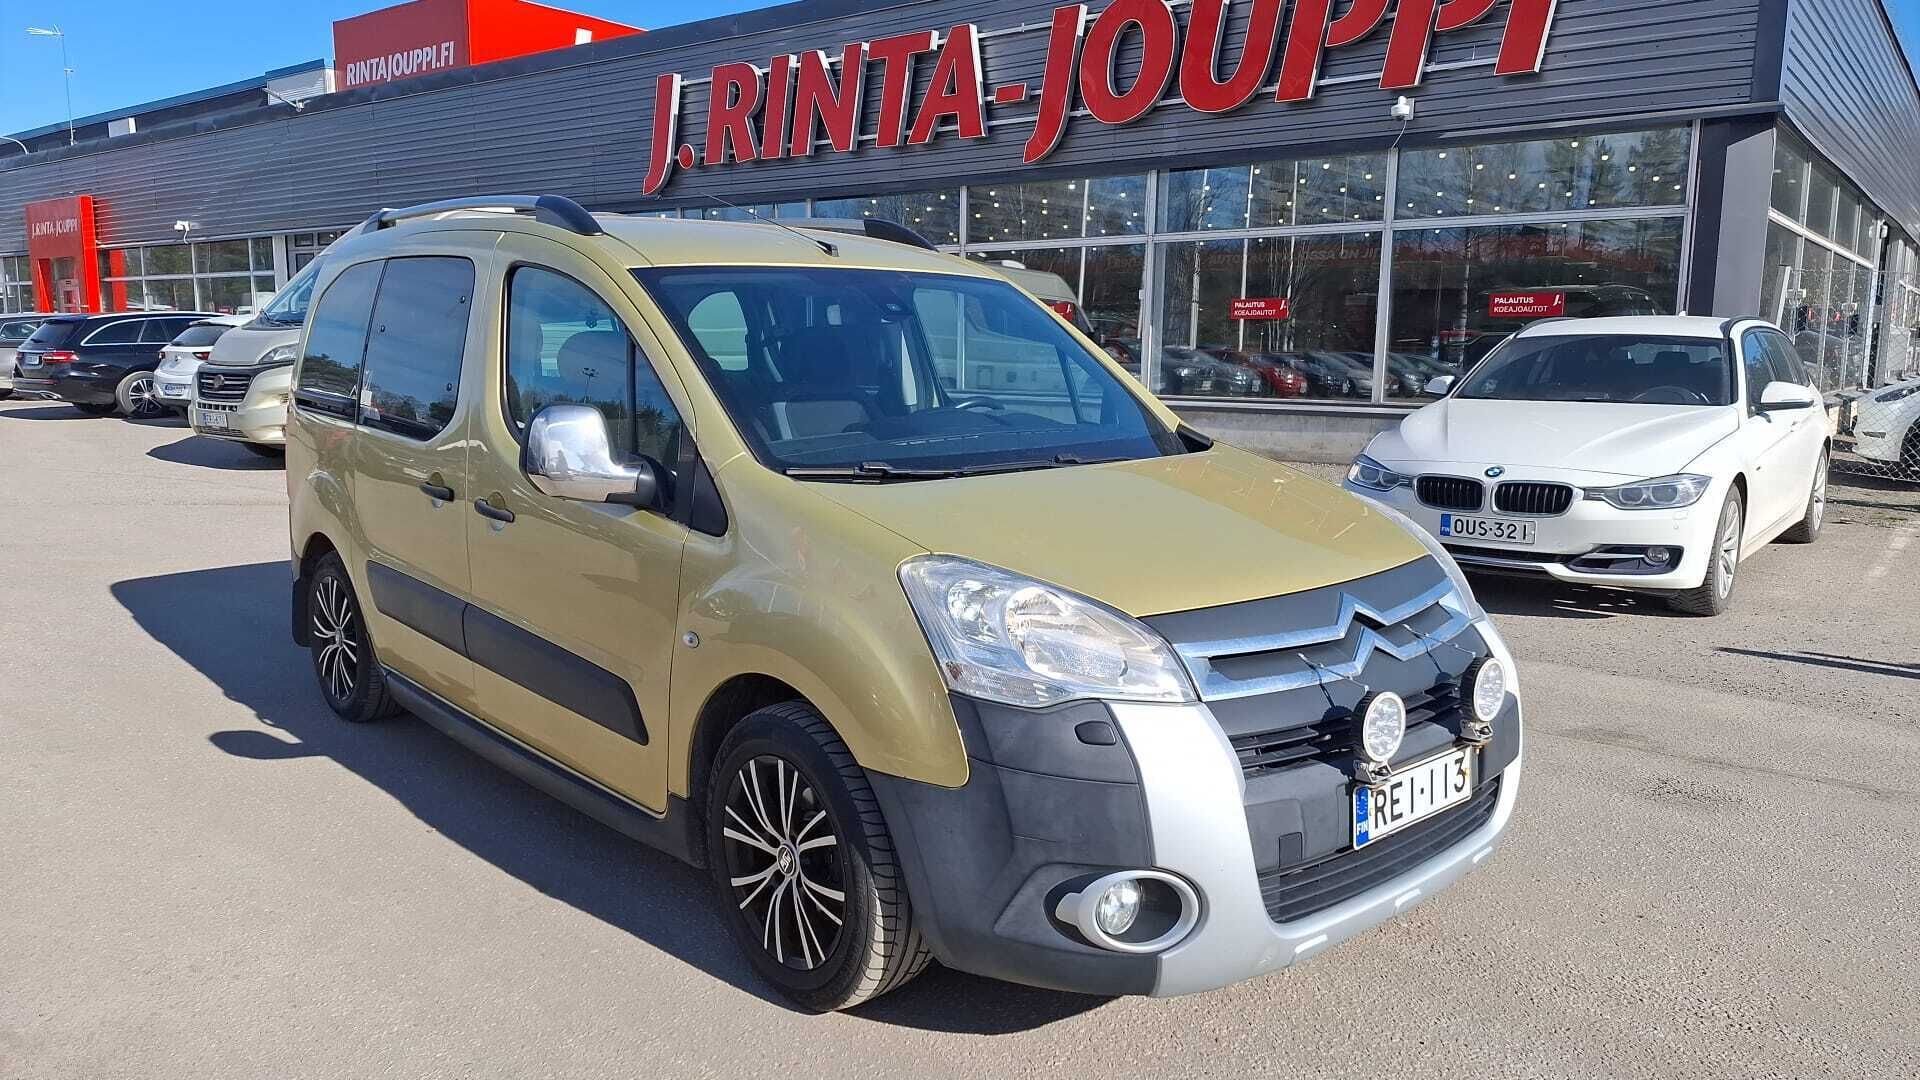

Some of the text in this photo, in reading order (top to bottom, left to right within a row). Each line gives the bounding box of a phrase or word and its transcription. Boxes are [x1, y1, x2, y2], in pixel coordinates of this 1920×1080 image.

[346, 41, 454, 86] RINTAJOUPPI.FI
[1494, 296, 1534, 304] PALAUTUS
[1493, 305, 1548, 313] KOEAJOAUTOT
[1373, 756, 1466, 830] REI-113
[1356, 820, 1369, 836] FIN
